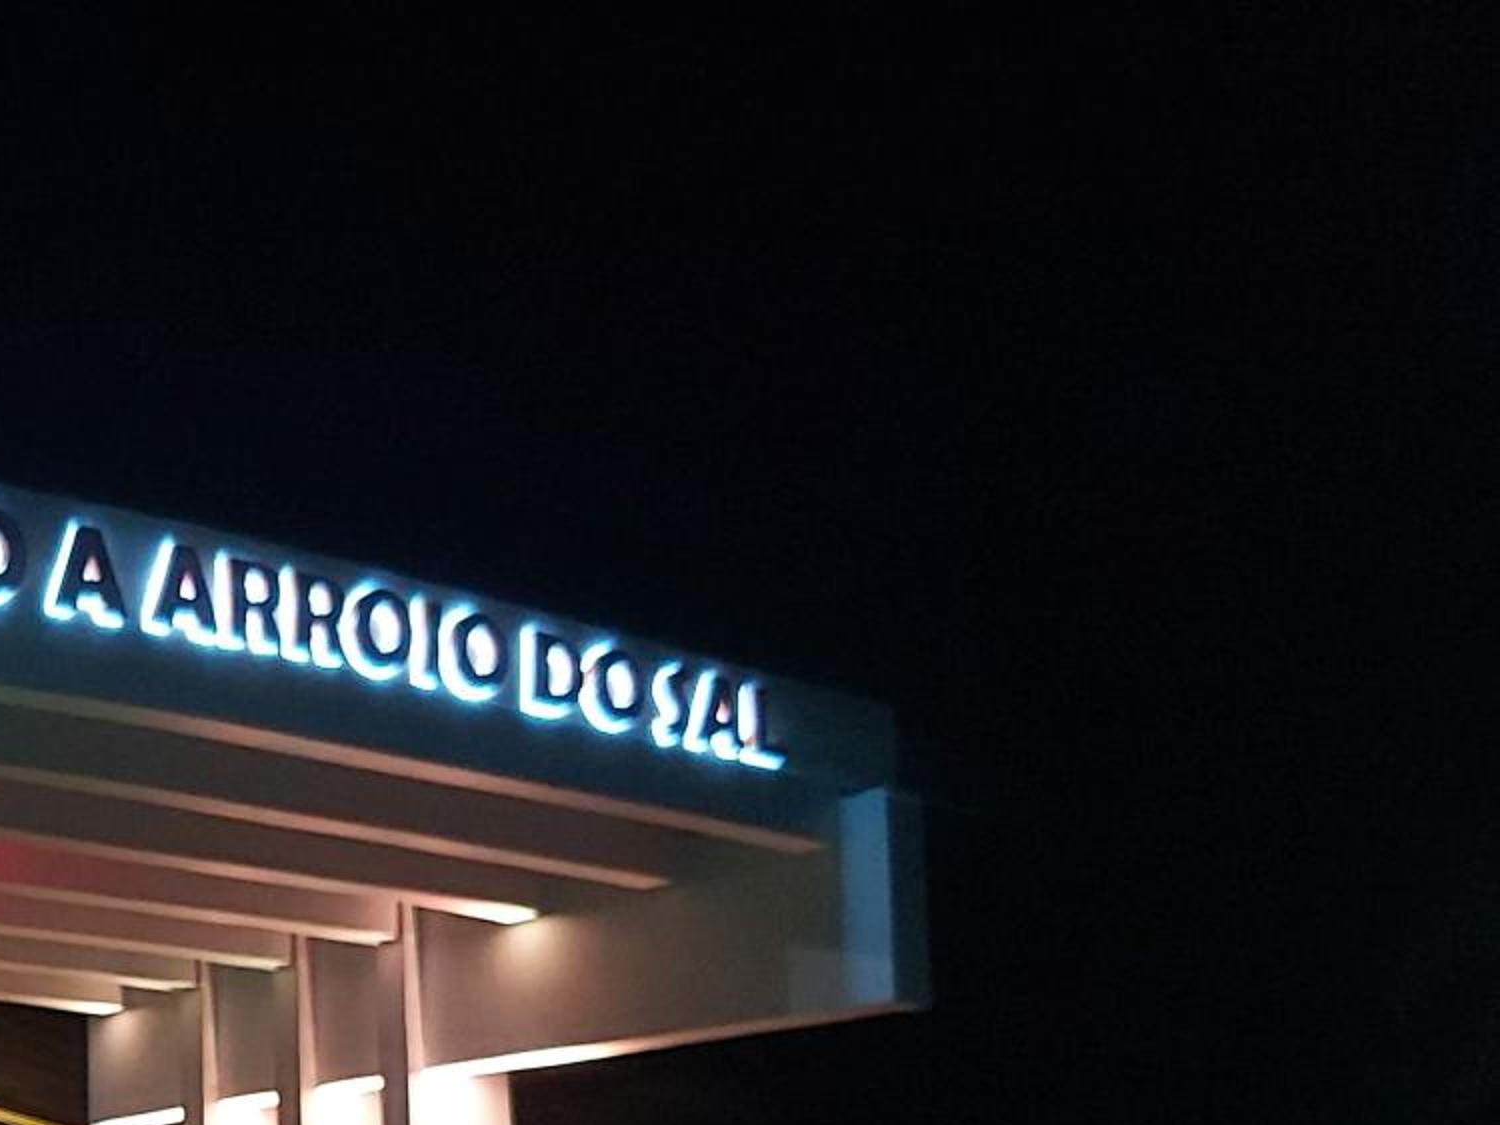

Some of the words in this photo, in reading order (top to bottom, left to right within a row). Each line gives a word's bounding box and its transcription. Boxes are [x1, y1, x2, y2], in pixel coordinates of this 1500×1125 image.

[43, 519, 125, 629] A
[140, 536, 505, 702] ARROIO
[518, 622, 641, 734] DO
[650, 660, 786, 771] SAL
